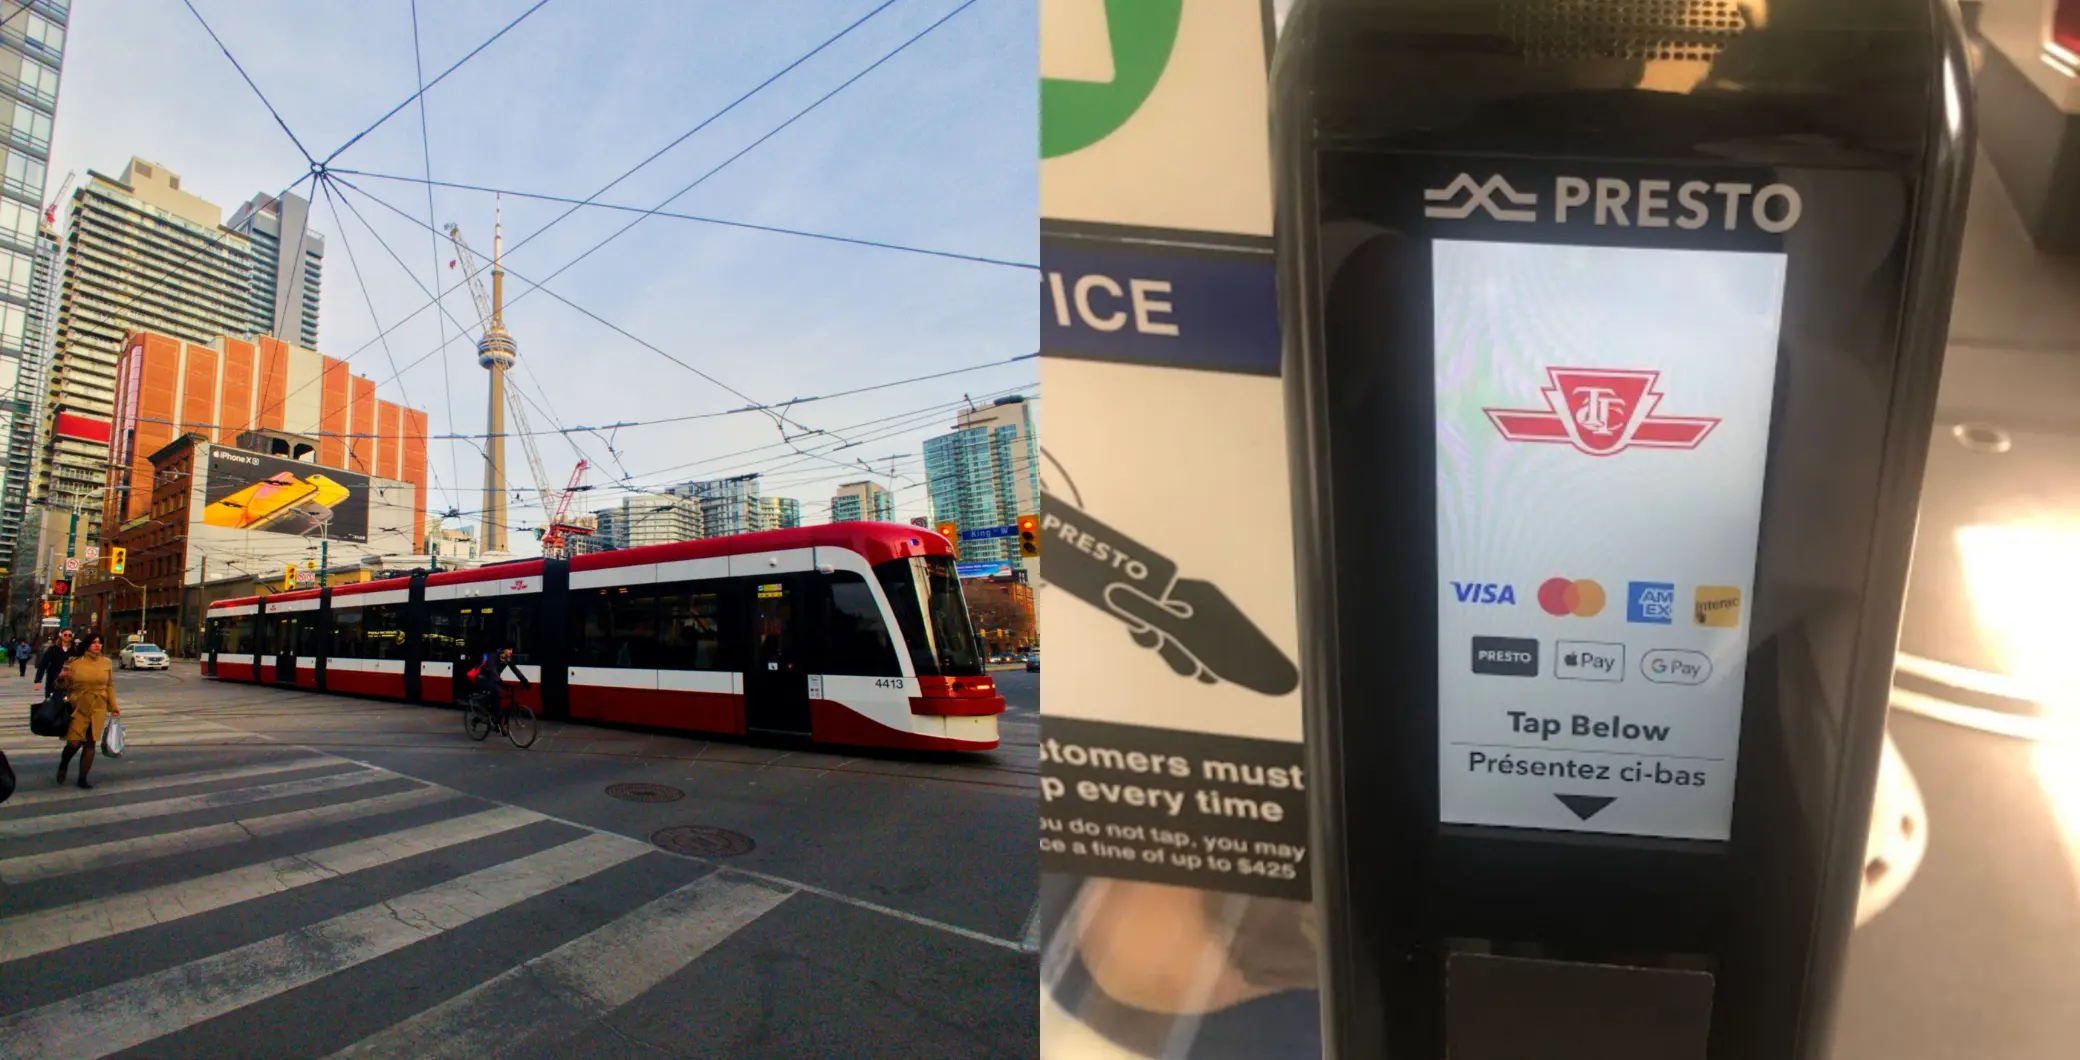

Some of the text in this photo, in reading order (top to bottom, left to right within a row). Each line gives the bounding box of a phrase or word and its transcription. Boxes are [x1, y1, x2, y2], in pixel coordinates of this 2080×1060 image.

[1555, 176, 1803, 234] PRESTO
[1040, 271, 1180, 337] ICE
[220, 451, 246, 463] iPhone
[1000, 526, 1008, 534] W
[1041, 513, 1148, 580] PRESTO
[1449, 581, 1516, 605] VISA
[1640, 588, 1674, 604] AM
[1478, 650, 1532, 663] PRESTO
[1581, 652, 1615, 672] Pay
[1671, 660, 1701, 678] Pay
[875, 679, 904, 689] 4413
[1507, 711, 1670, 741] Tap Below
[1202, 760, 1305, 790] must
[1469, 751, 1706, 786] Présentez ci-bas
[1076, 780, 1184, 816] every
[1195, 789, 1284, 822] time
[1069, 818, 1100, 836] do
[1106, 824, 1145, 841] not
[1203, 836, 1248, 853] you
[1254, 841, 1306, 863] may
[1072, 842, 1087, 855] a
[1091, 841, 1136, 861] fine
[1141, 849, 1165, 864] of
[1171, 854, 1202, 871] up
[1207, 856, 1232, 872] to
[1237, 858, 1297, 880] $425
